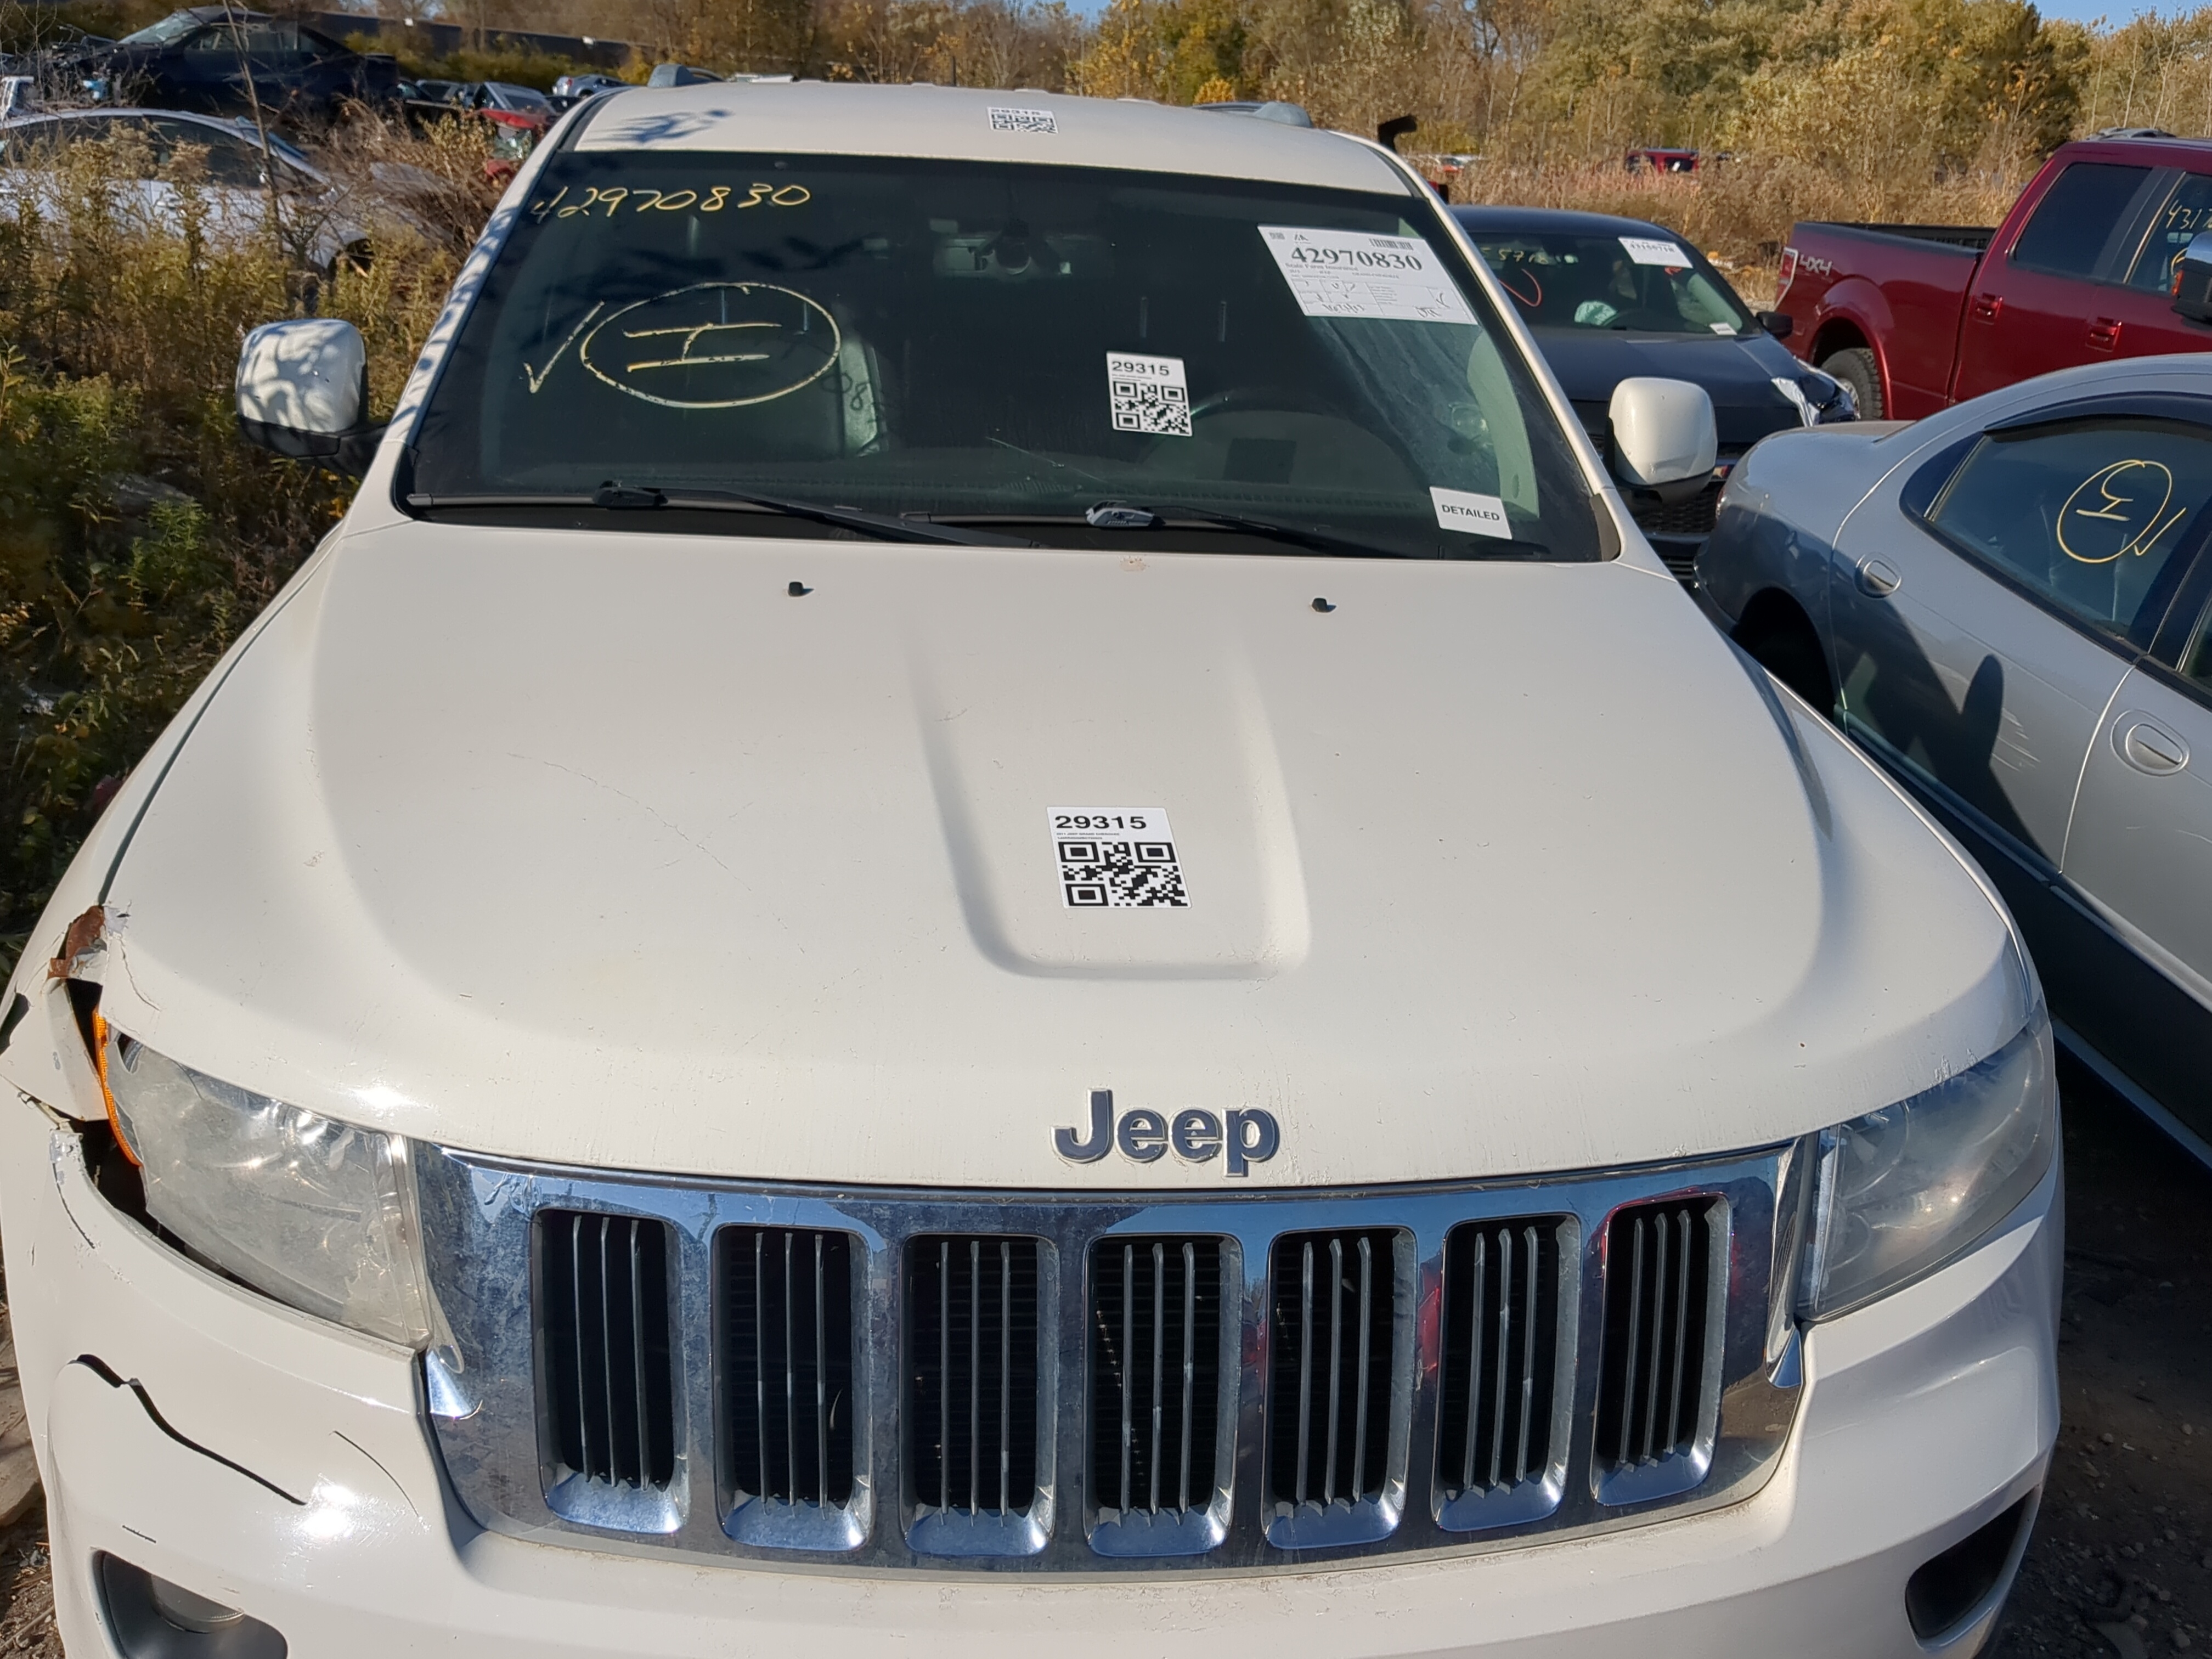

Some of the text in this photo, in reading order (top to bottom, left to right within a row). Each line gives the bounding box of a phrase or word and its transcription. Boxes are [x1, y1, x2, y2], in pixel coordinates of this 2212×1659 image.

[531, 183, 811, 223] 42970830
[1291, 247, 1423, 270] 42970830
[1112, 361, 1170, 375] 29315
[1442, 504, 1500, 521] DETAILED
[1055, 815, 1147, 829] 29315
[1051, 1088, 1280, 1177] Jeep
